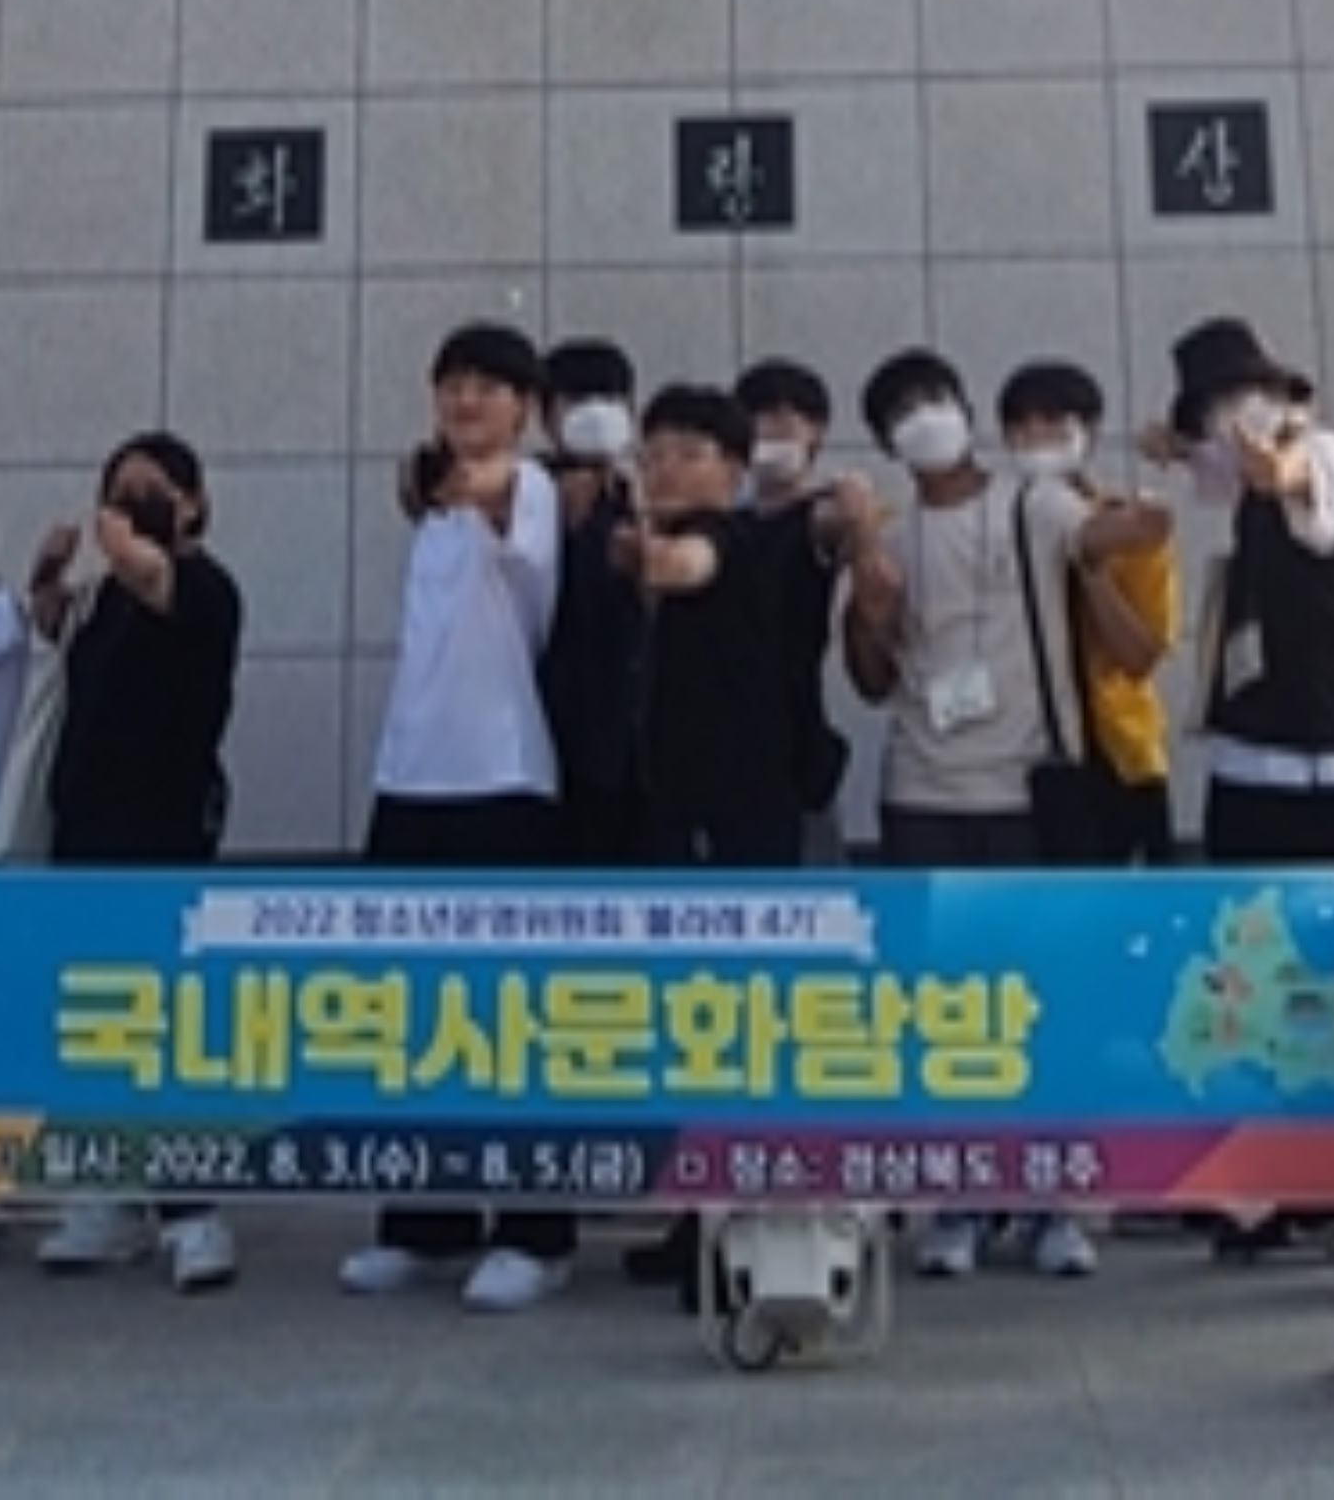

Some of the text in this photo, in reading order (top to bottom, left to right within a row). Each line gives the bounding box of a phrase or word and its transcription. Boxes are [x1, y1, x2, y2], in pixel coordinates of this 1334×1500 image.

[232, 116, 1241, 231] 화 랑 상
[250, 900, 339, 938] 2022
[757, 903, 816, 940] 4기
[56, 964, 1039, 1096] 국내역사문화탐방
[144, 1136, 256, 1184] 2022.
[267, 1137, 308, 1184] 8.
[482, 1140, 523, 1184] 8.
[842, 1142, 1001, 1194] 경상북도
[1023, 1142, 1101, 1194] 경주
